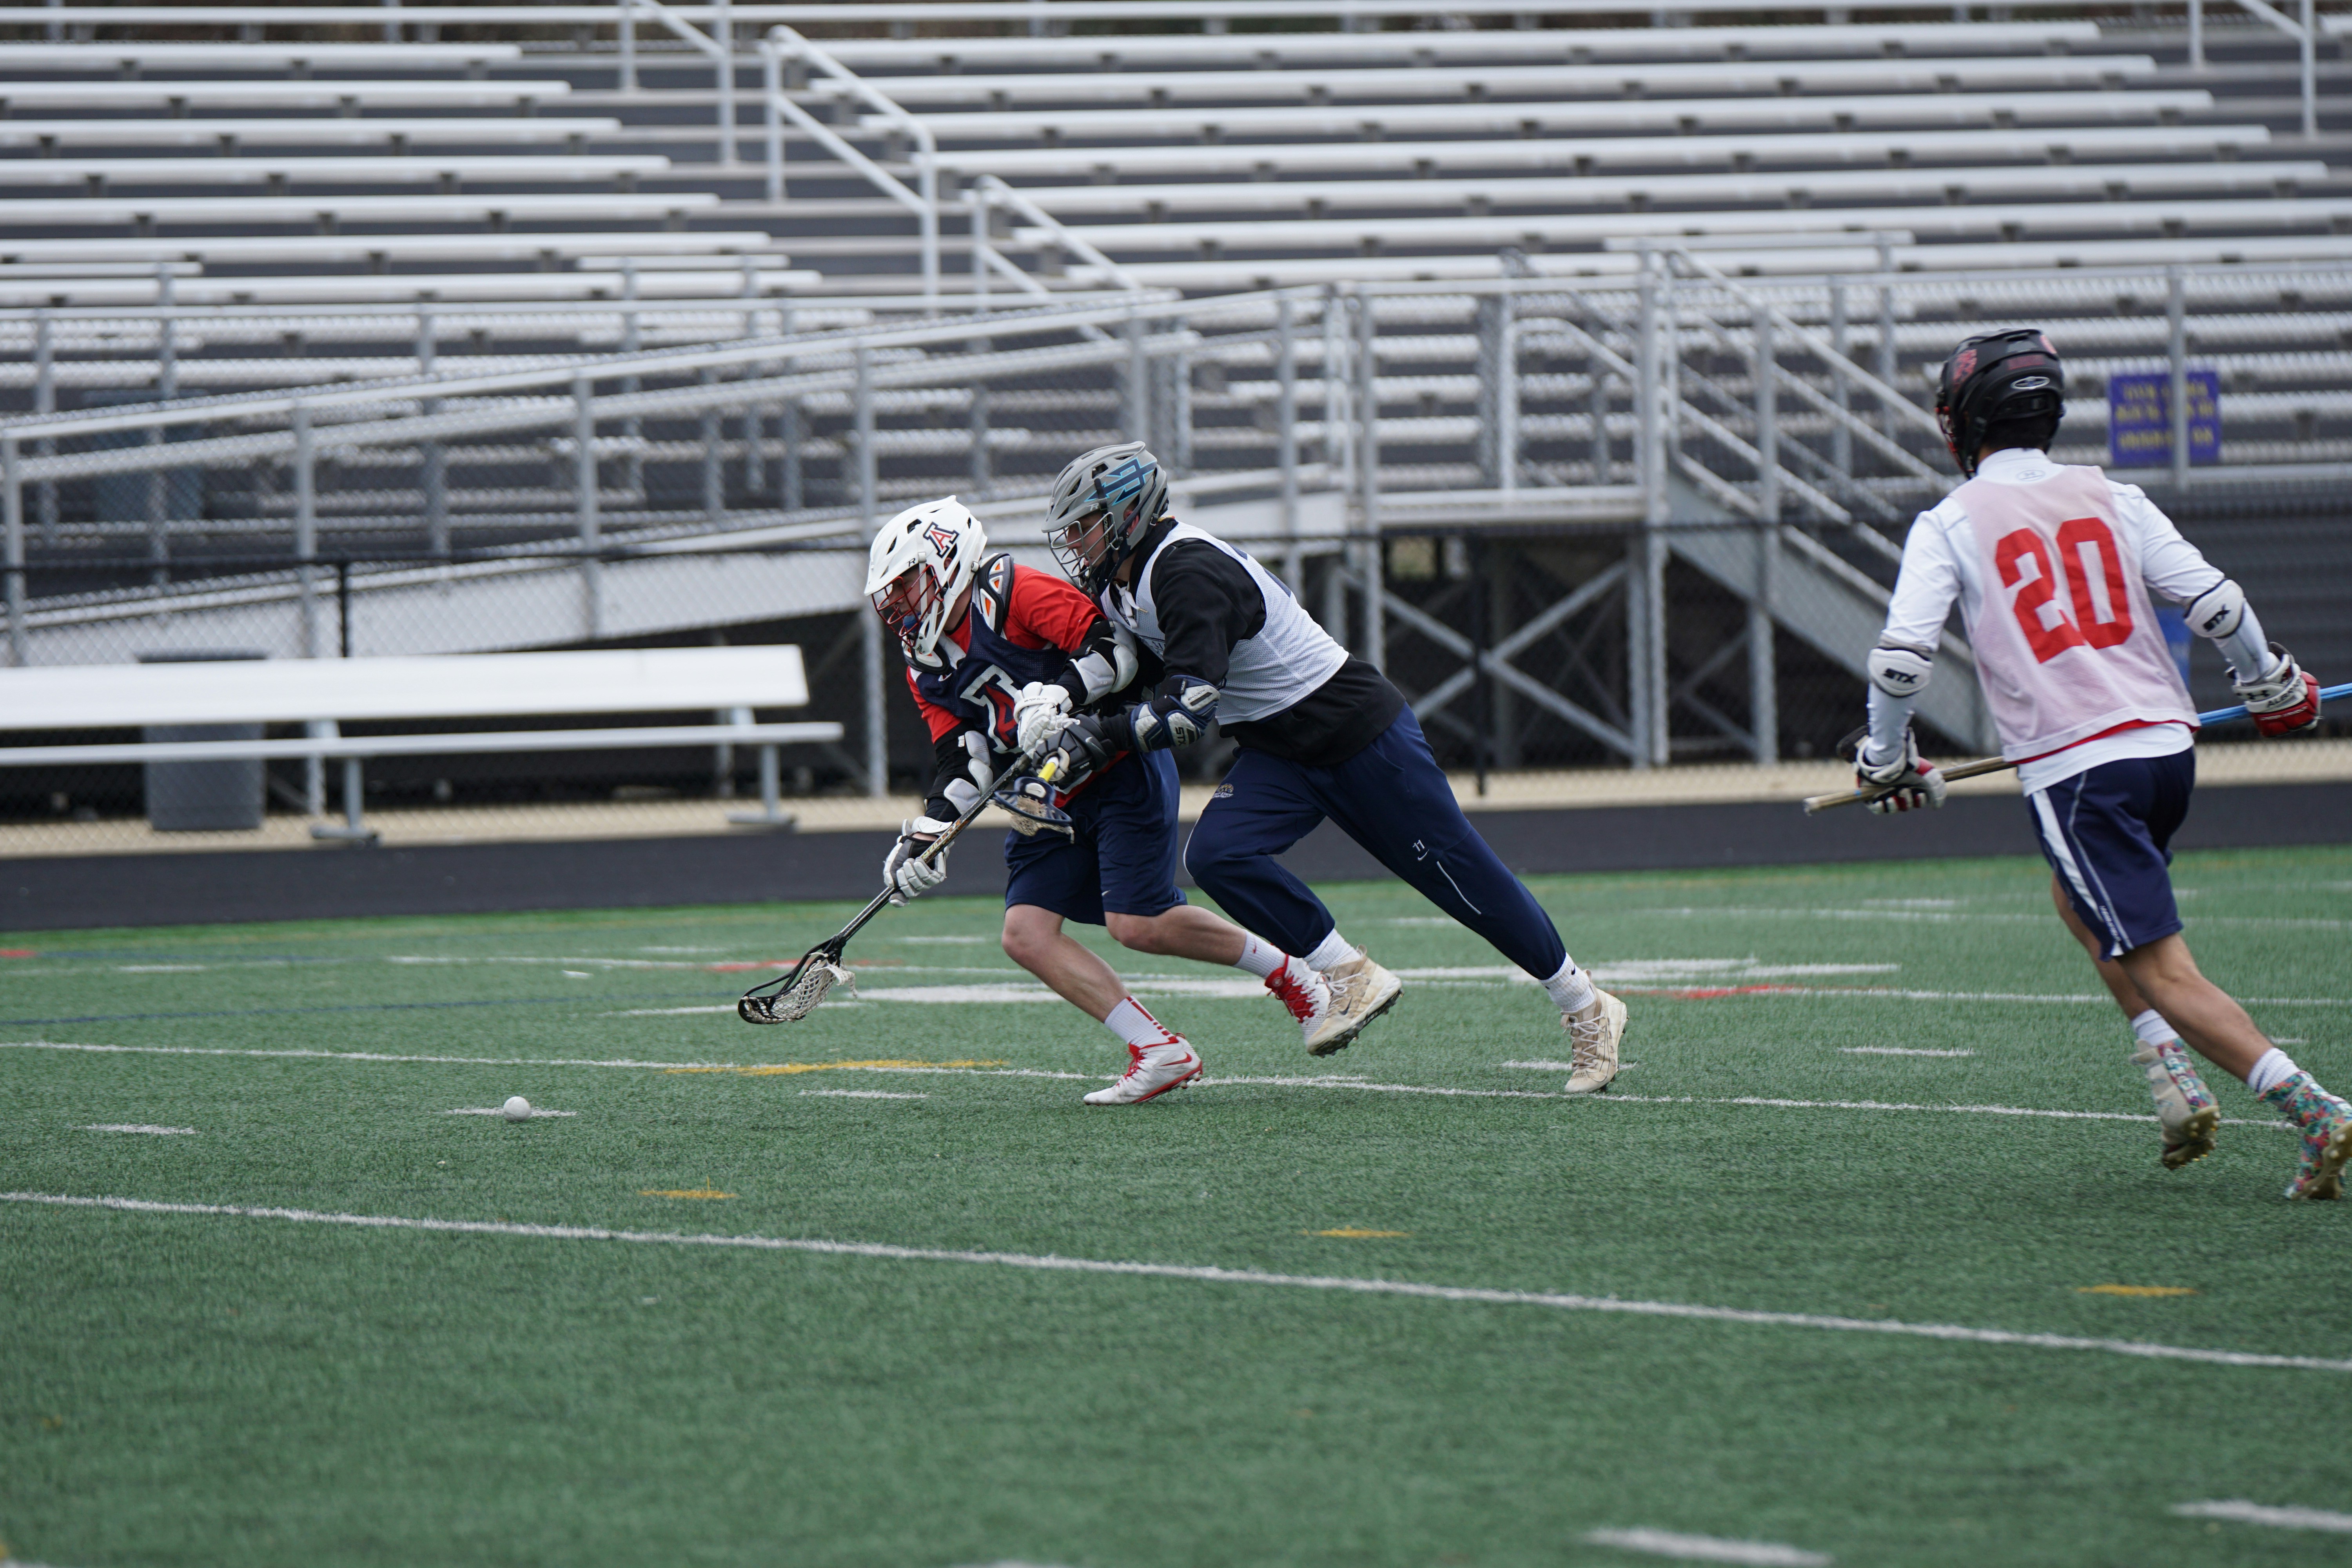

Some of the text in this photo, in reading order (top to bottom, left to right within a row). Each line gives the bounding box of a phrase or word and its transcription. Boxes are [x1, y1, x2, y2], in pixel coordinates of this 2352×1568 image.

[923, 521, 960, 558] A
[1995, 517, 2135, 664] 20
[2203, 603, 2231, 632] STX
[1882, 668, 1919, 684] STX
[1188, 689, 1205, 701] SHADOW
[1175, 727, 1186, 746] STX
[1412, 839, 1425, 851] 11
